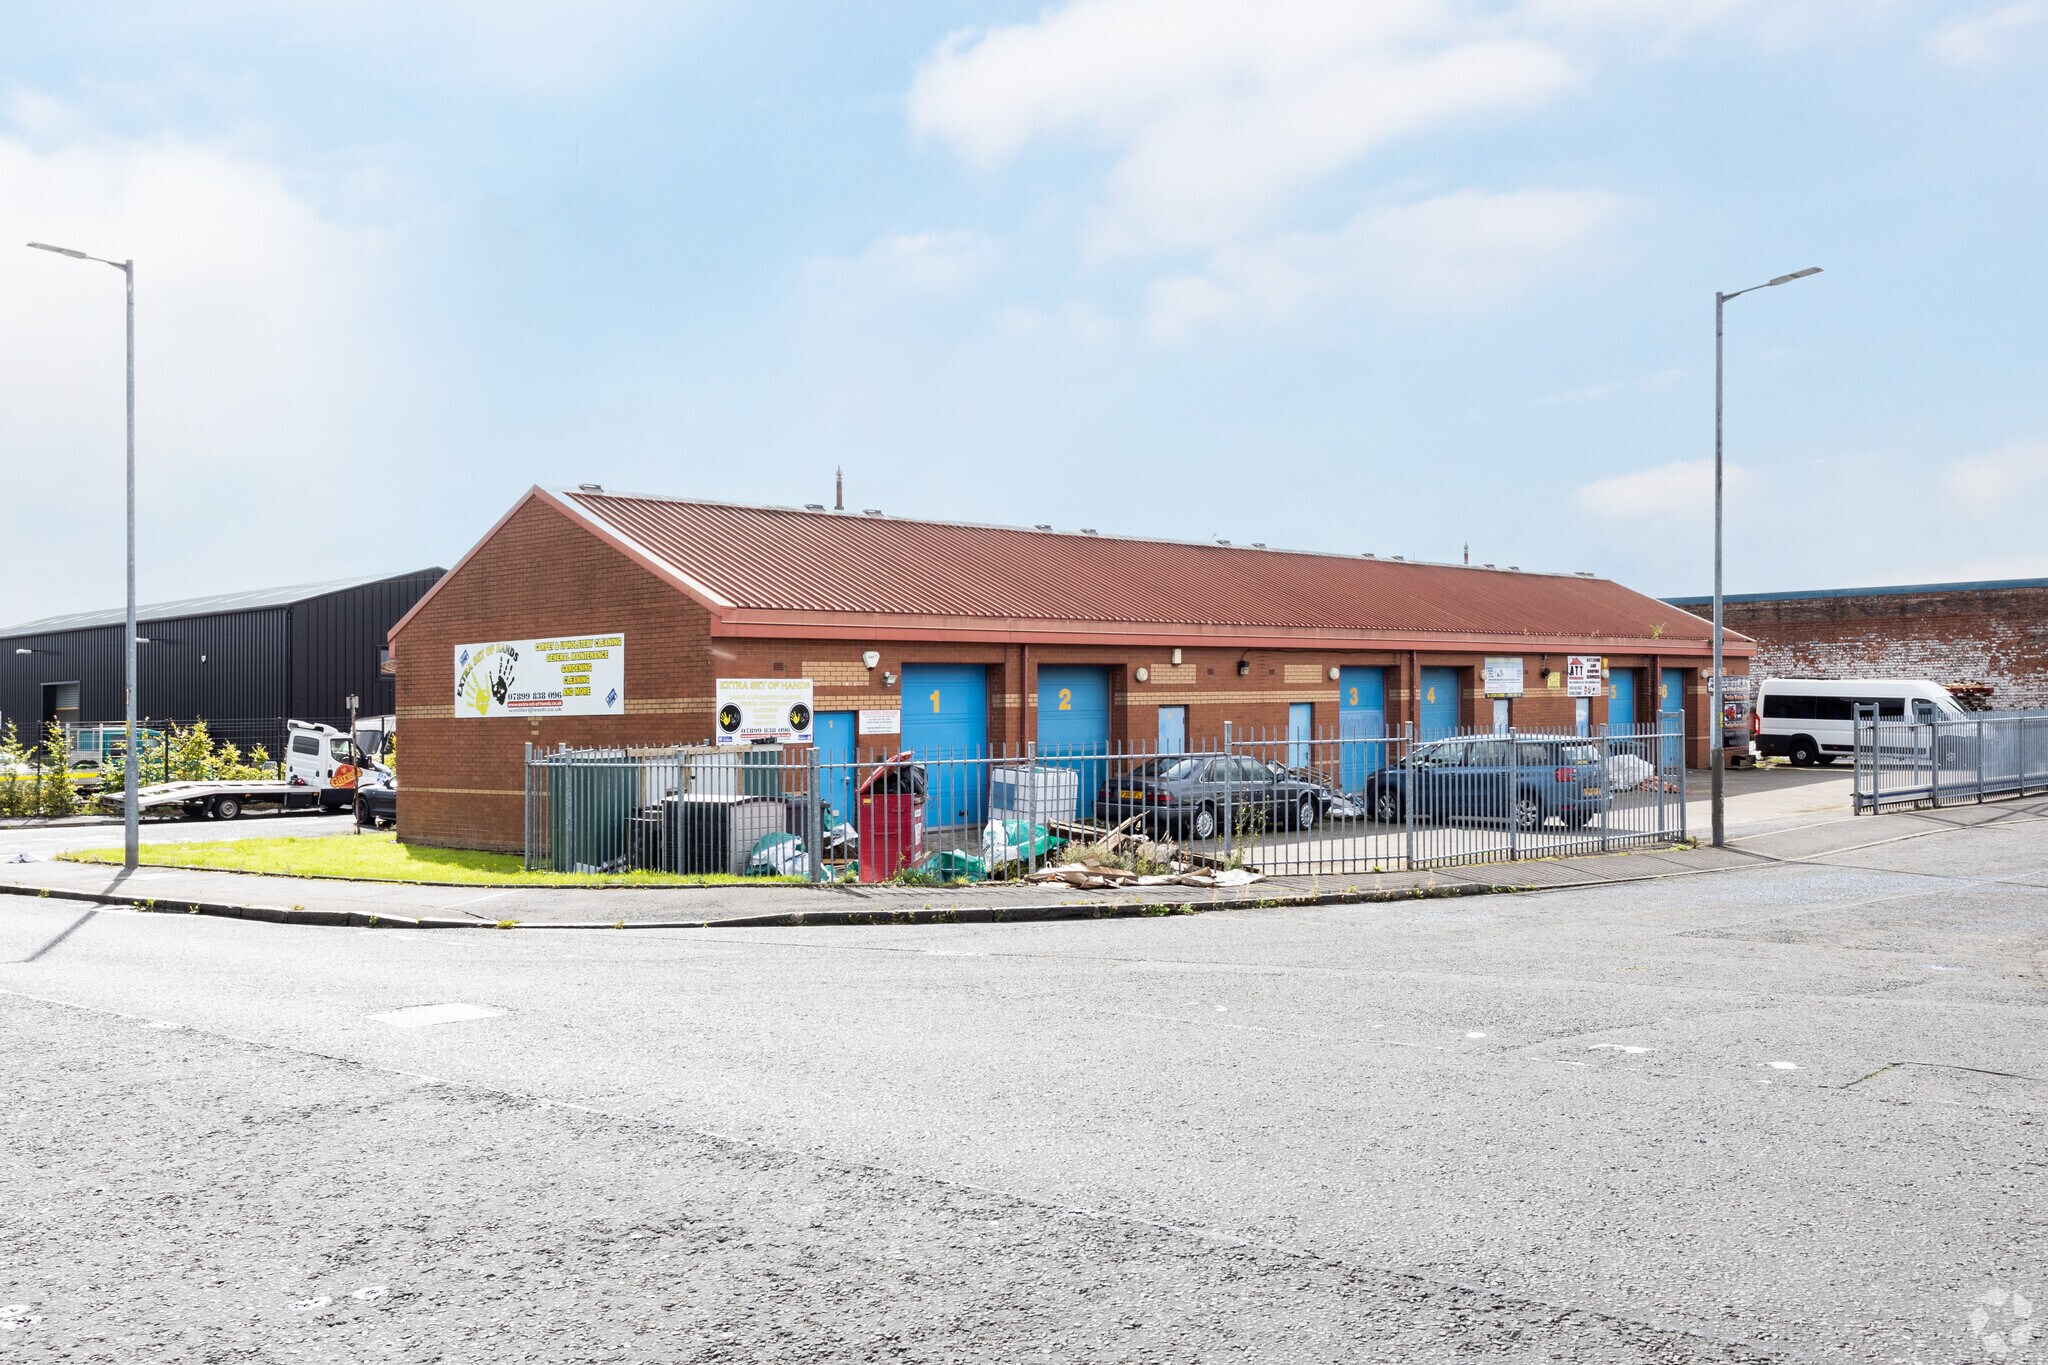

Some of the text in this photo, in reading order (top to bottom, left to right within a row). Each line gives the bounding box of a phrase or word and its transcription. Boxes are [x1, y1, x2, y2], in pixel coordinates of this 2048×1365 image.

[535, 637, 622, 651] CARPET & UPHOLSTERY CLEANING
[546, 650, 609, 662] GENERAL MAINTENANCE
[457, 663, 473, 697] EXTRA
[473, 649, 484, 666] SET
[496, 643, 519, 661] HANDS
[561, 663, 592, 673] GARDENING
[563, 675, 590, 685] CLEANING
[719, 681, 810, 690] EXTRA SET OF HANDS
[508, 692, 530, 700] 07899
[548, 691, 562, 699] 096
[563, 686, 591, 696] AND MORE
[1349, 687, 1359, 706] 3
[1427, 687, 1436, 704] 4
[1610, 684, 1617, 699] 5
[1662, 684, 1668, 699] 6
[929, 690, 940, 713] 1
[1058, 688, 1072, 710] 2
